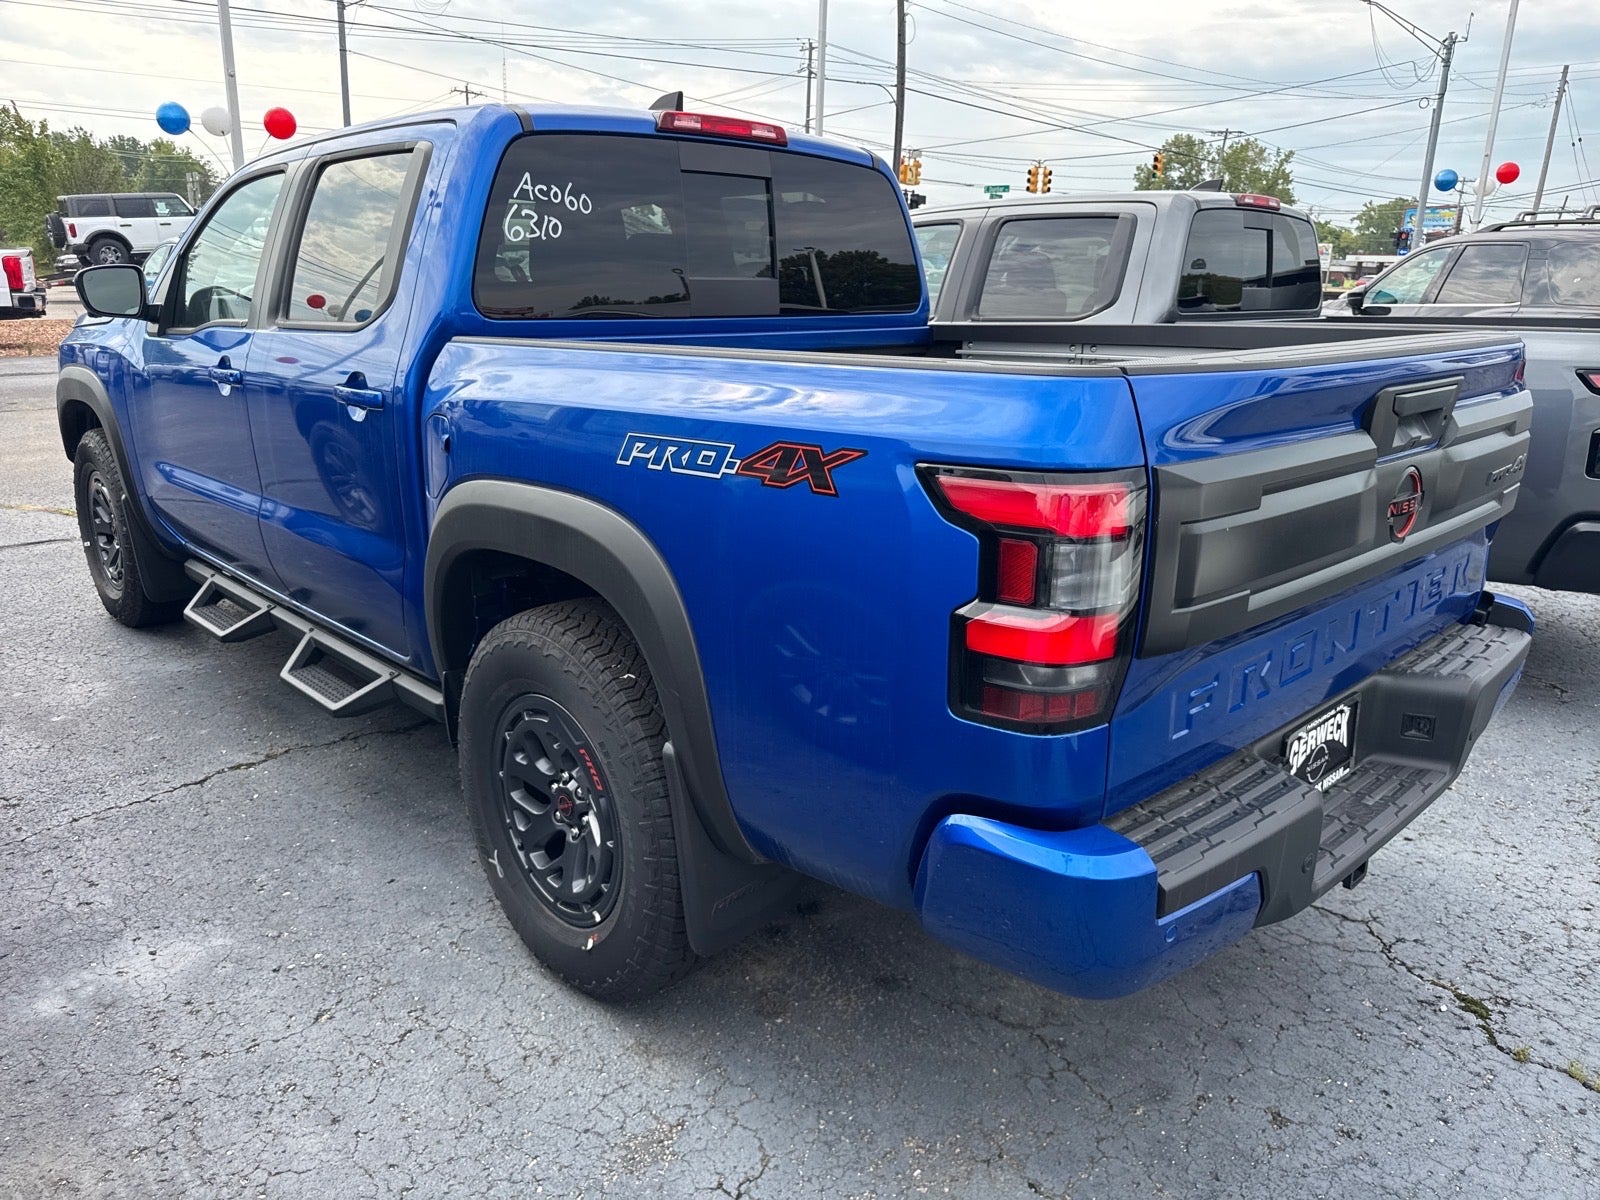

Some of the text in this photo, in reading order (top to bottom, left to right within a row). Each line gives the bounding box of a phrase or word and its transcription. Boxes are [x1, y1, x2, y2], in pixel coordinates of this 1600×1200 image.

[503, 203, 563, 242] 6310
[1387, 499, 1416, 517] NISS
[1169, 552, 1472, 741] FRONTIER
[1289, 708, 1351, 776] GERWECK
[578, 747, 604, 791] PRO
[1306, 754, 1329, 773] NISSAN
